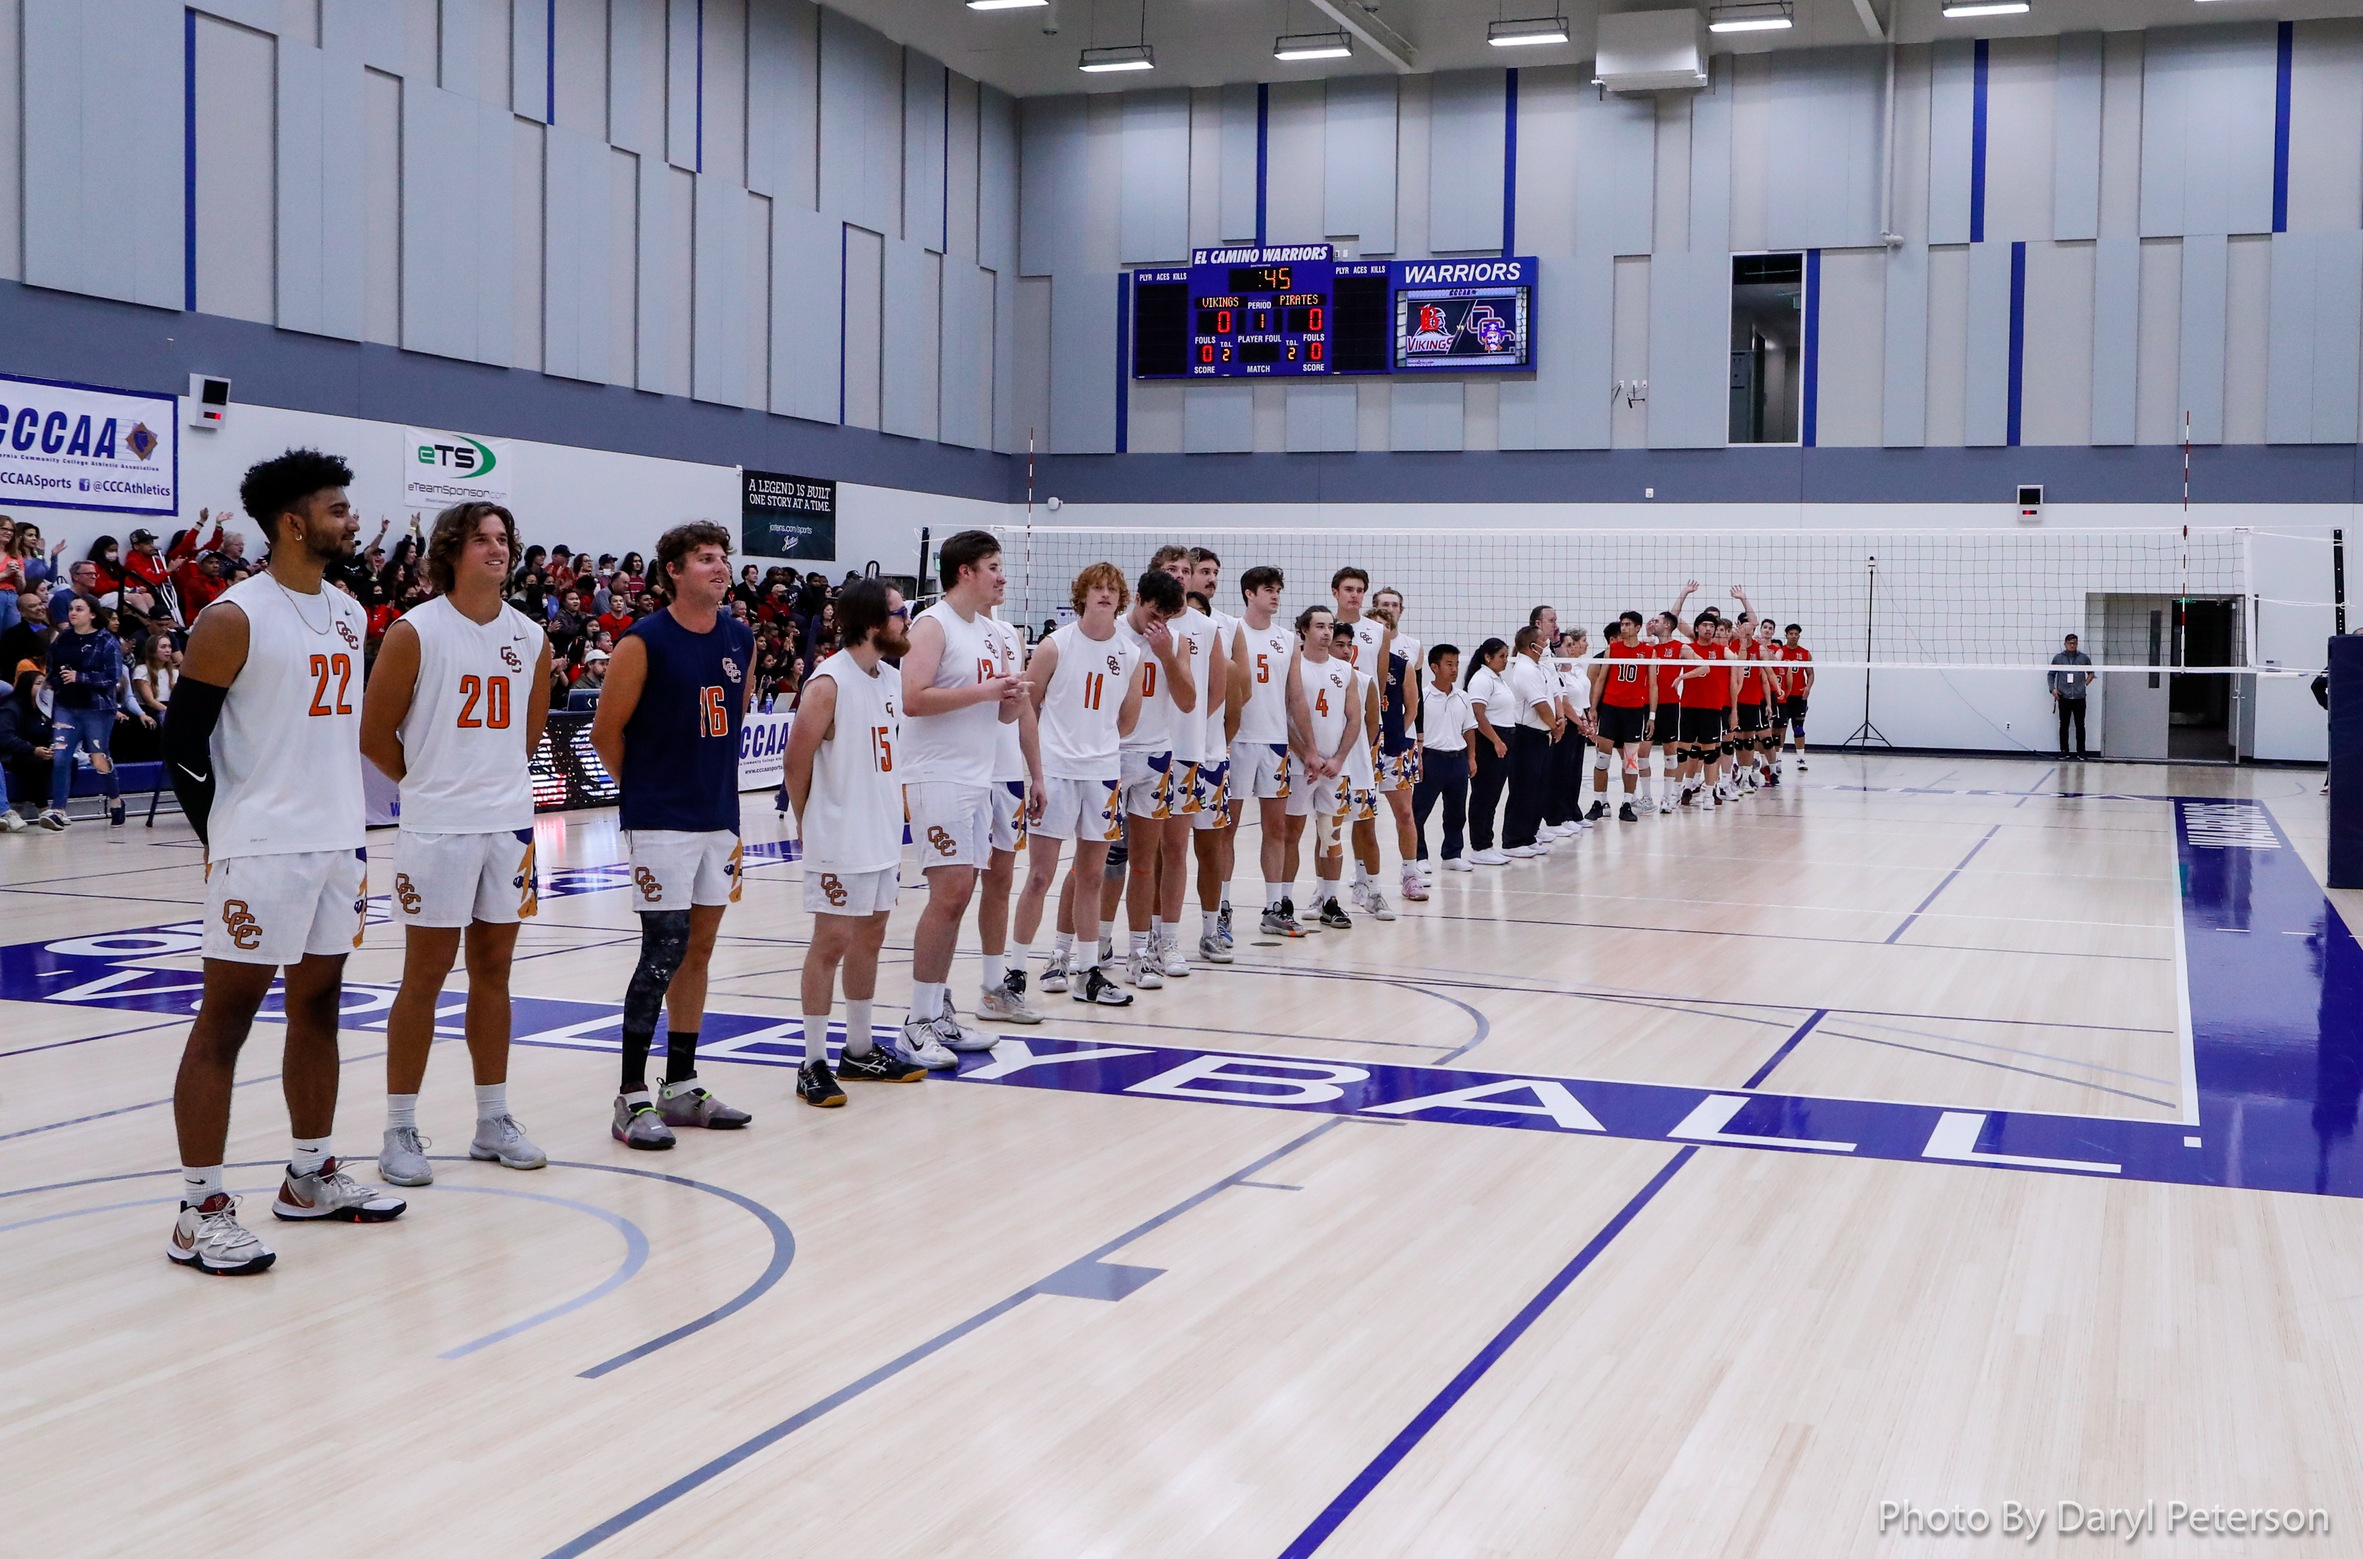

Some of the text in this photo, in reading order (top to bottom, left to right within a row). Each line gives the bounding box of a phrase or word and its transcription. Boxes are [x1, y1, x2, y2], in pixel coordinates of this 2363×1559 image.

[1194, 246, 1328, 264] EL CAMINO WARRIORS
[1139, 271, 1187, 282] PLYR ACES KILLS
[1335, 265, 1386, 275] PLYR ACES KILLS
[1405, 262, 1521, 284] WARRIORS
[1202, 297, 1239, 308] VIKINGS
[1247, 301, 1272, 310] PERIOD
[1279, 294, 1319, 305] PIRATES
[1217, 310, 1231, 333] 0
[1260, 313, 1265, 329] 1
[1308, 308, 1322, 331] 0
[1194, 336, 1216, 345] FOULS
[1238, 334, 1282, 344] PLAYER FOUL
[1303, 333, 1325, 342] FOULS
[1201, 345, 1213, 363] 0
[1222, 348, 1230, 362] 2
[1287, 347, 1296, 360] 2
[1310, 342, 1322, 360] 0
[1194, 366, 1215, 374] SCORE
[1247, 365, 1271, 373] MATCH
[1303, 364, 1325, 372] SCORE
[20, 454, 60, 464] Community
[62, 458, 89, 466] College
[91, 461, 119, 469] Athletic
[93, 480, 171, 497] @CCCAthletics
[748, 479, 831, 500] A LEGEND IS BUILT
[749, 493, 831, 512] ONE STORY AT A TIME.
[1257, 654, 1269, 683] 5
[1617, 664, 1638, 683] 10
[309, 653, 352, 717] 22
[1084, 671, 1104, 710] 11
[457, 674, 510, 729] 20
[1315, 688, 1329, 717] 4
[700, 685, 728, 738] 16
[927, 825, 957, 857] OCC
[635, 866, 662, 902] OCC
[820, 872, 847, 907] OCC
[395, 872, 422, 915] OCC
[222, 899, 262, 950] OCC
